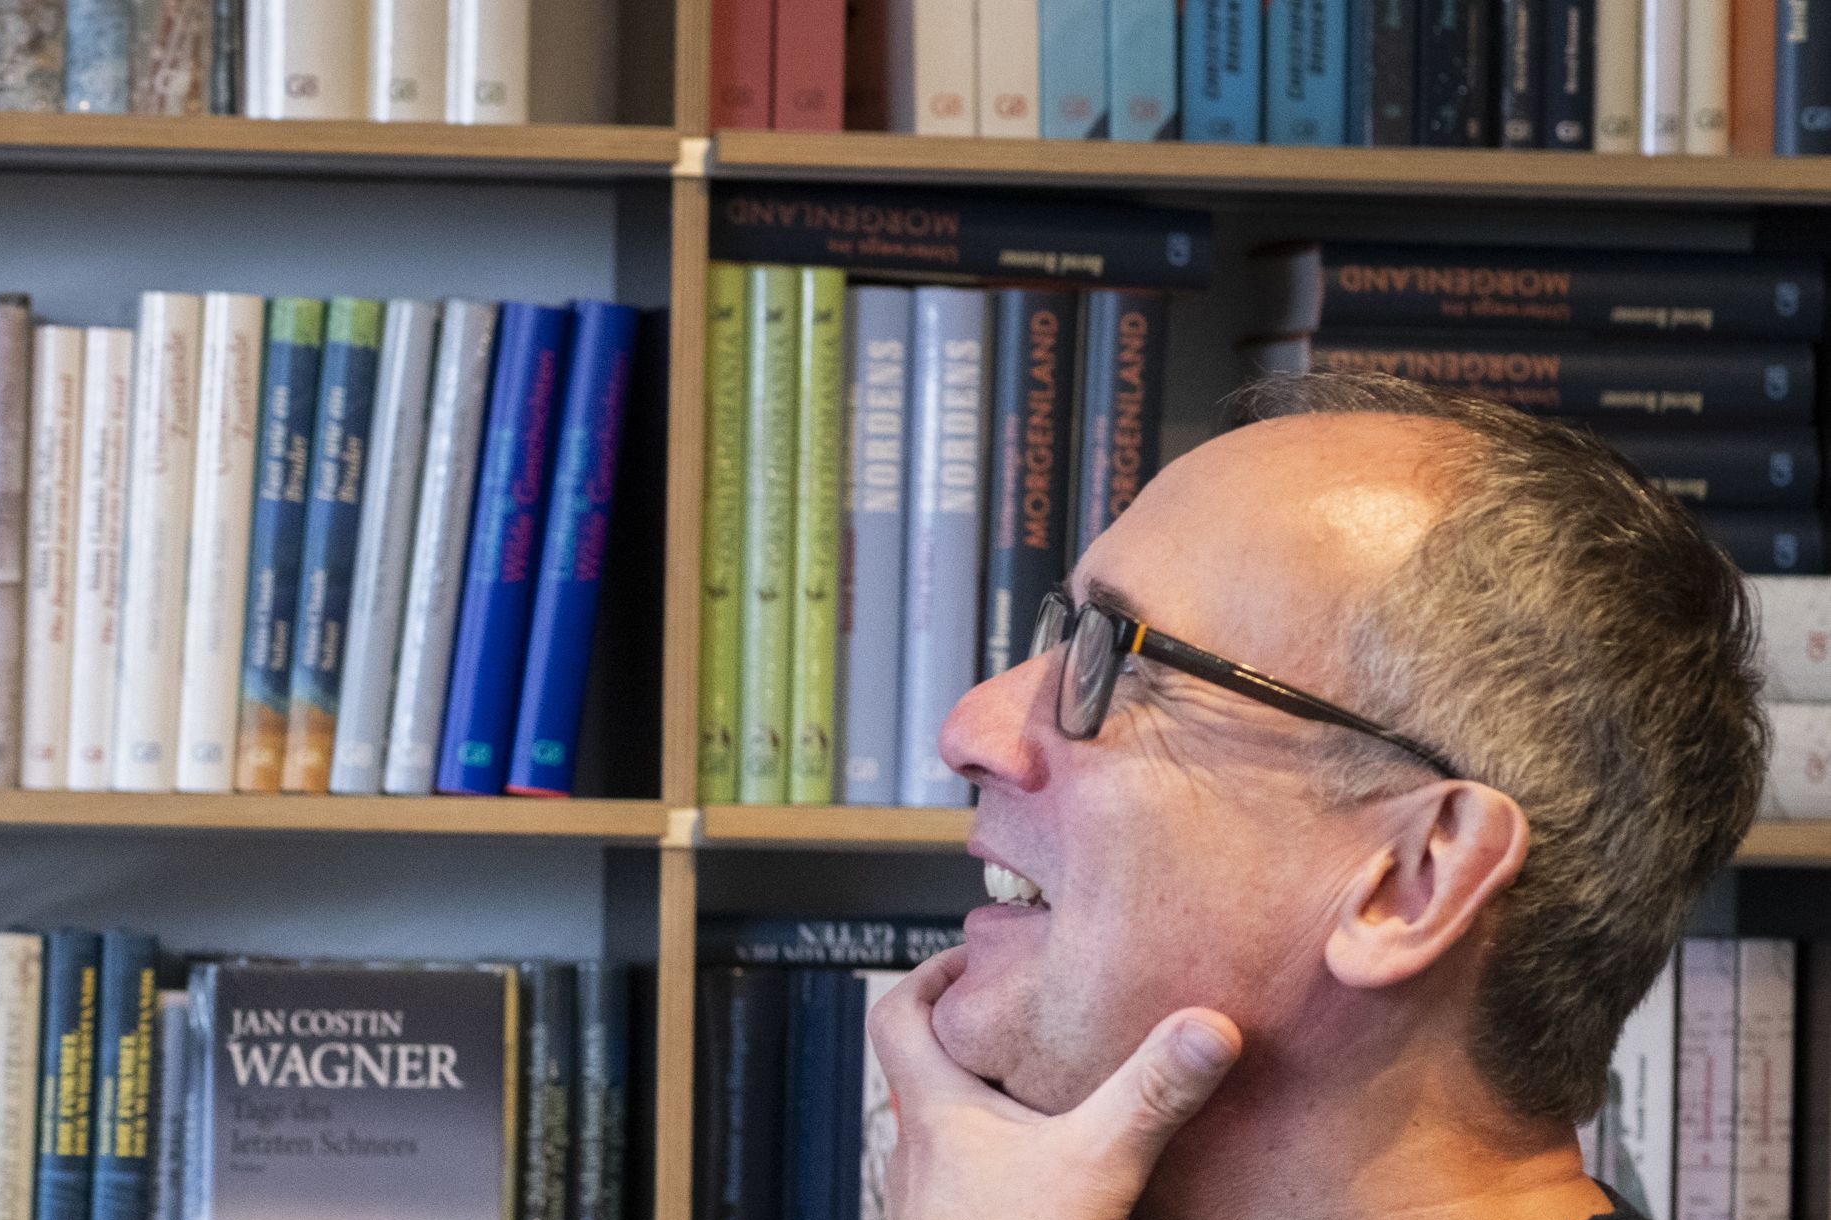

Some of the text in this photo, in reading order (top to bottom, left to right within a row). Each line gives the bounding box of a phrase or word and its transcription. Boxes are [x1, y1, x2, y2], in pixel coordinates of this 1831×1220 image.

[1338, 265, 1570, 298] MORGENLAND
[863, 340, 905, 513] NORDENS
[939, 340, 981, 513] NORDENS
[1023, 311, 1059, 549] MORGENLAND
[227, 1041, 465, 1090] WAGNER
[230, 1008, 405, 1043] JAN COSTIN
